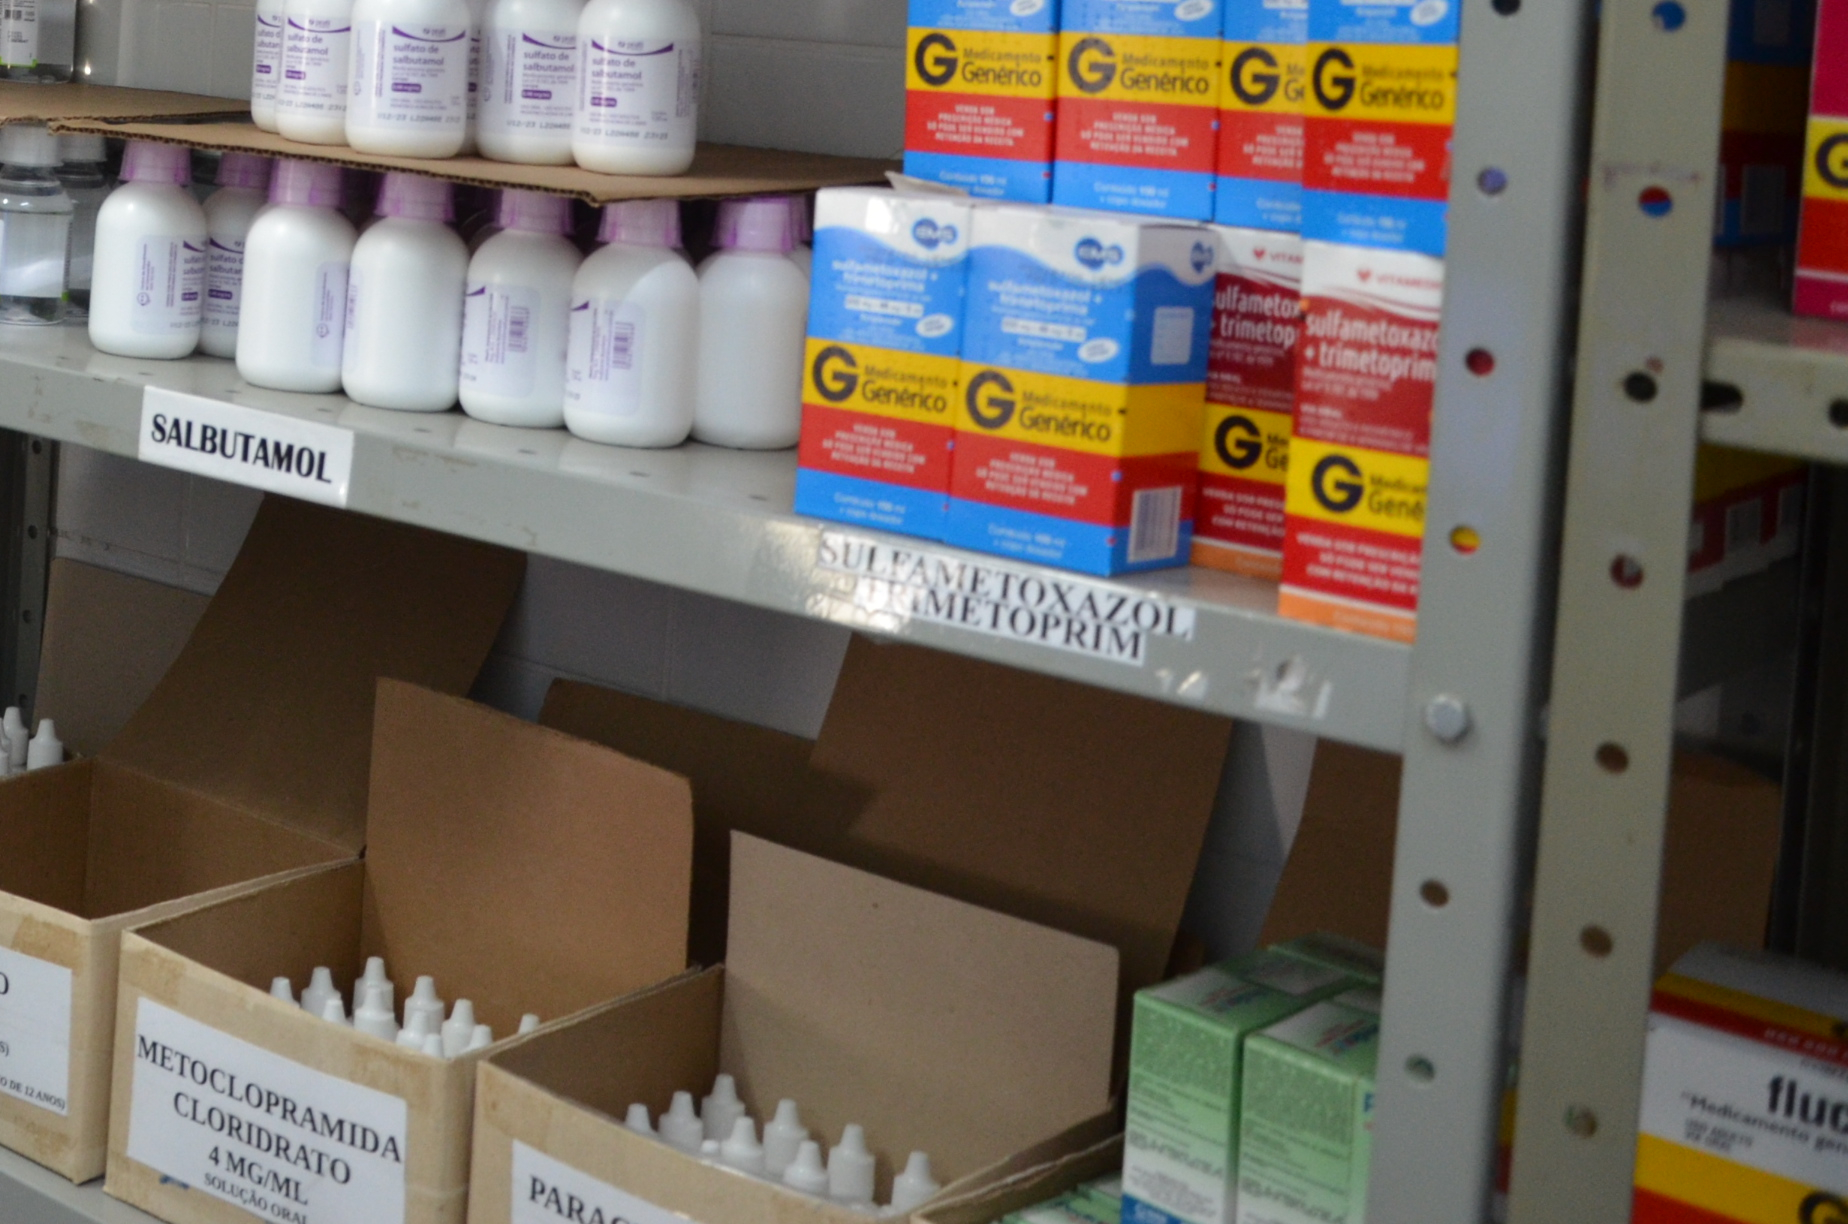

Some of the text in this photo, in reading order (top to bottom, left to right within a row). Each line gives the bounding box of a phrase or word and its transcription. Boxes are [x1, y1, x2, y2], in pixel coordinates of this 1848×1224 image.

[393, 43, 439, 54] sulfato de
[393, 55, 445, 66] salbutamol
[523, 62, 575, 73] salbutamol
[524, 50, 569, 61] sulfato de
[623, 57, 636, 68] de
[915, 33, 958, 87] G
[962, 61, 1042, 87] Genérico
[1068, 37, 1209, 94] G Medicamento
[1120, 67, 1209, 95] Genérico
[1230, 47, 1280, 106] G
[1313, 48, 1356, 111] G
[1360, 80, 1444, 111] Genérico
[1214, 284, 1301, 319] ulfametox
[813, 346, 947, 402] G Medicamento
[862, 379, 947, 413] Genérico
[966, 370, 1016, 430] G
[151, 414, 333, 484] SALBUTAMOL
[1019, 405, 1111, 442] Genérico
[1214, 415, 1263, 470] G
[1311, 454, 1364, 513] G
[821, 539, 1192, 639] SULFAMETOXAZOL
[862, 579, 1142, 661] TRIMETOPRIM
[9, 1080, 22, 1093] DE
[25, 1085, 34, 1097] 12
[35, 1089, 65, 1111] ANOS)
[137, 1034, 402, 1163] METOCLOPRAMIDA
[173, 1091, 352, 1185] CLORIDRATO
[204, 1172, 309, 1224] SOLUÇÃO ORAL
[208, 1145, 309, 1206] 4 MG/ML
[530, 1173, 630, 1224] PARA
